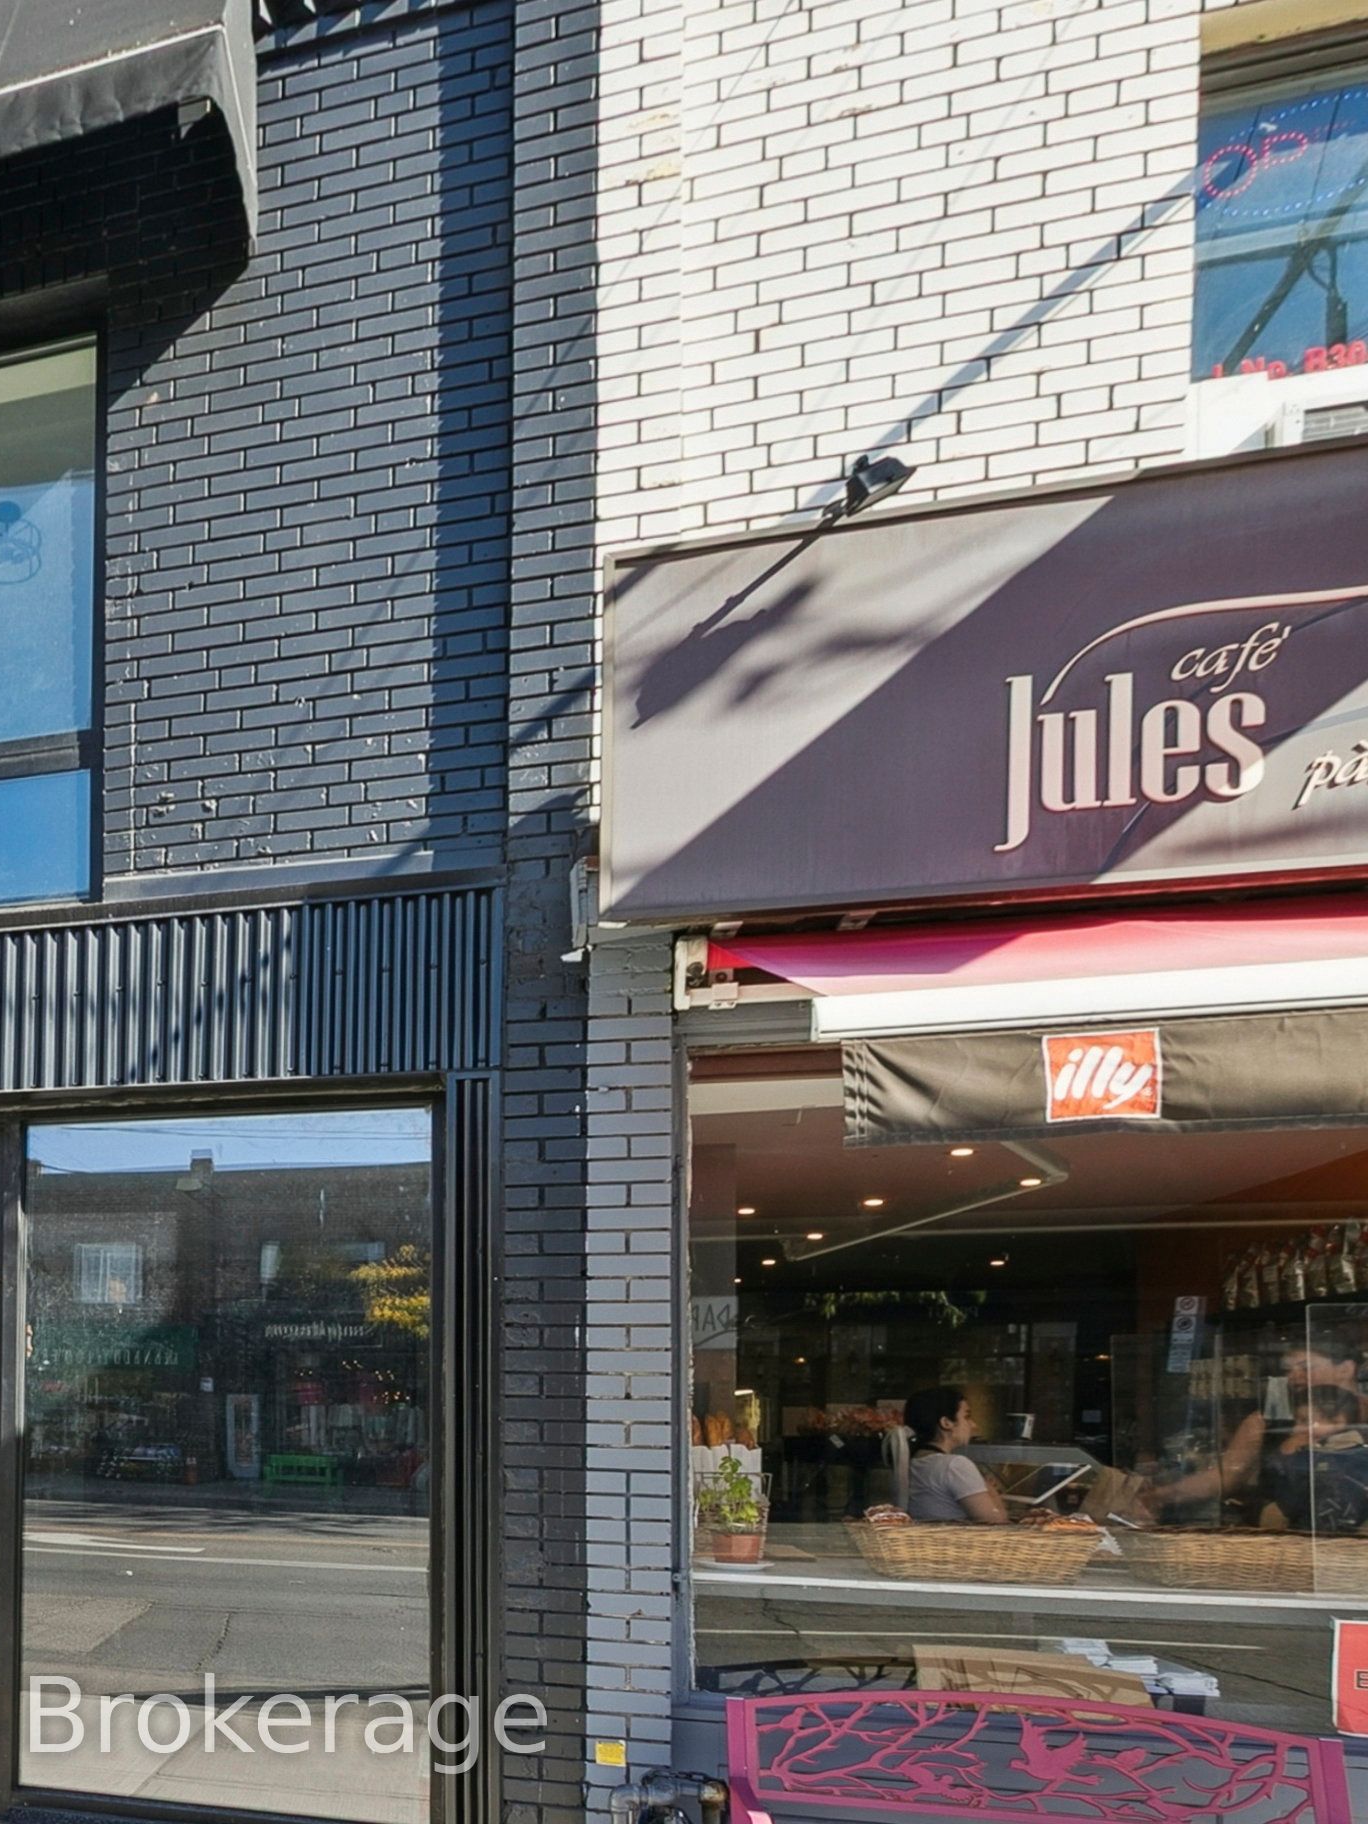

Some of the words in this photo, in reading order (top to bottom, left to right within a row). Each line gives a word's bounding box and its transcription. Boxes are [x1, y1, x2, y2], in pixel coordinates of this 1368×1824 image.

[1171, 622, 1292, 693] café
[994, 672, 1267, 852] Jules
[1054, 1045, 1153, 1110] illy
